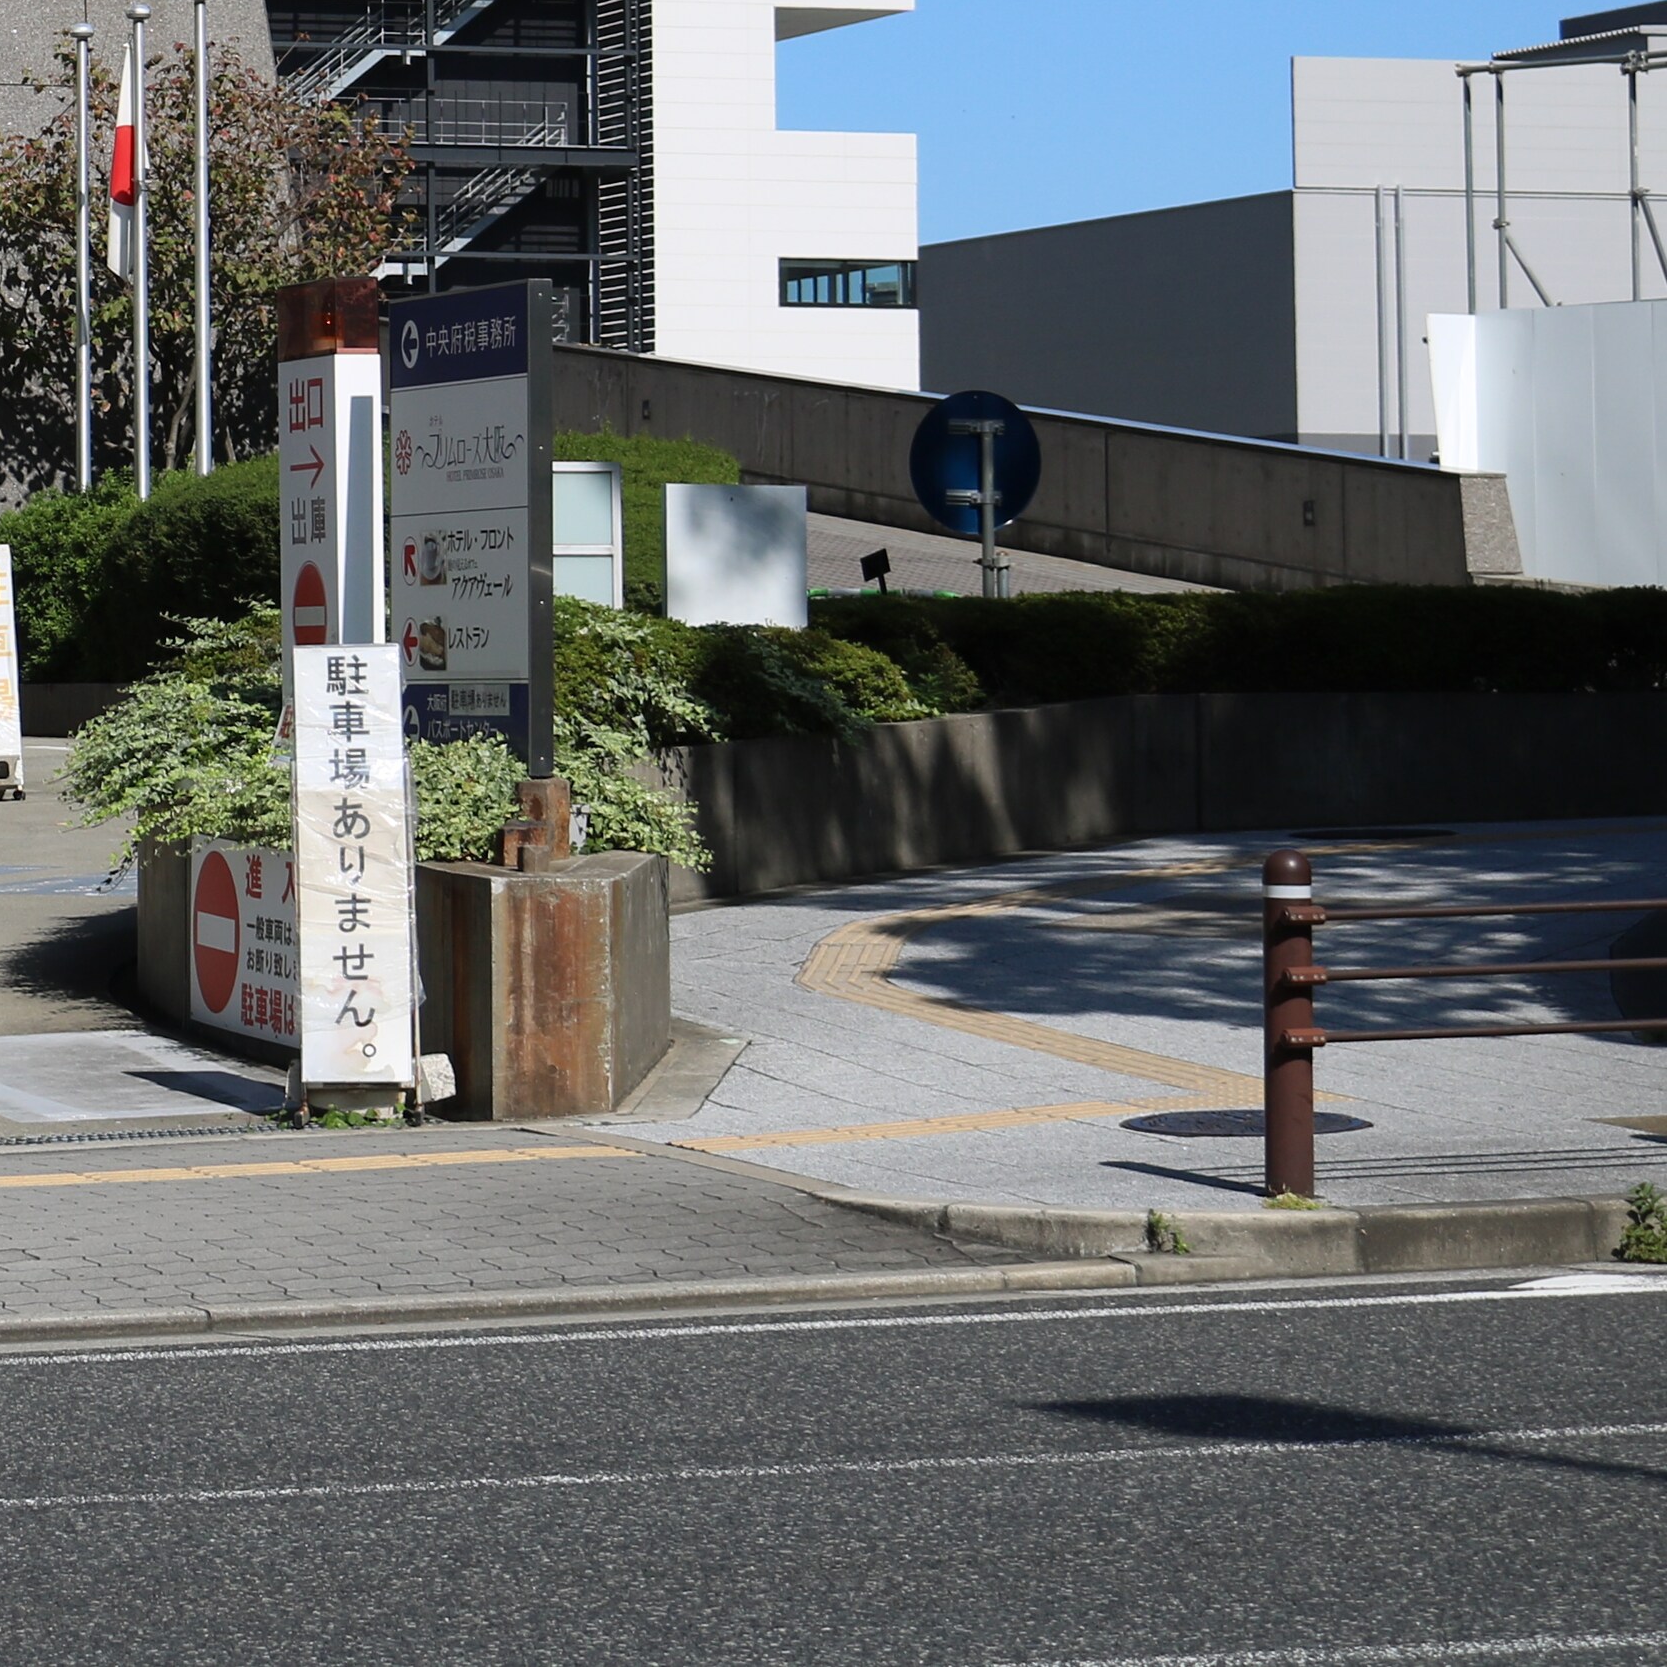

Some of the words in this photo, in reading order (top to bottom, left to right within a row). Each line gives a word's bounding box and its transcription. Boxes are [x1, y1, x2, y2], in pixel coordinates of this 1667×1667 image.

[424, 315, 517, 358] 中央府税事務所
[288, 376, 324, 433] 出口
[424, 425, 510, 469] プリムローズ大阪
[290, 495, 327, 546] 出庫
[447, 526, 515, 553] ホテル・フロント
[451, 572, 514, 600] アクアヴェール
[448, 626, 490, 650] レストラン
[450, 688, 507, 711] 駐車場ありません
[326, 653, 377, 1058] 駐車場ありません。
[240, 982, 296, 1036] 駐車場は
